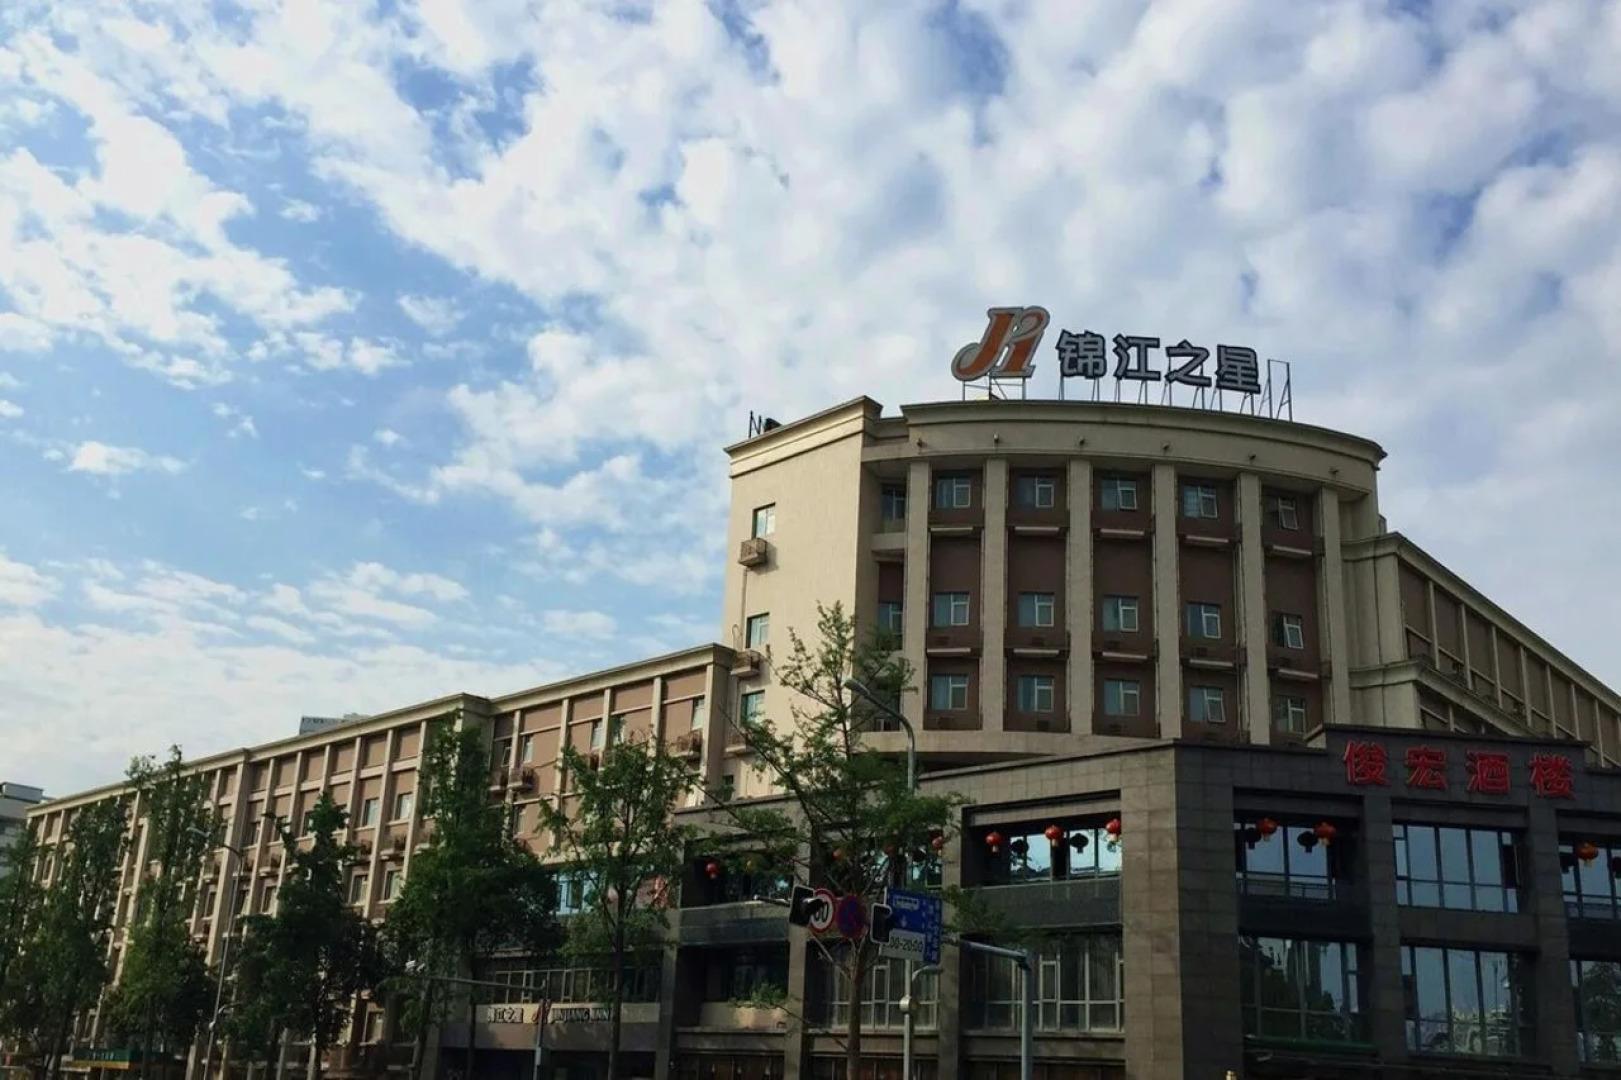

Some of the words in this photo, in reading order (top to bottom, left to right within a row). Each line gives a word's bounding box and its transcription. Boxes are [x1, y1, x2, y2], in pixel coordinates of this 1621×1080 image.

[1056, 330, 1261, 394] 锦江之星
[1343, 741, 1575, 797] 俊宏酒楼
